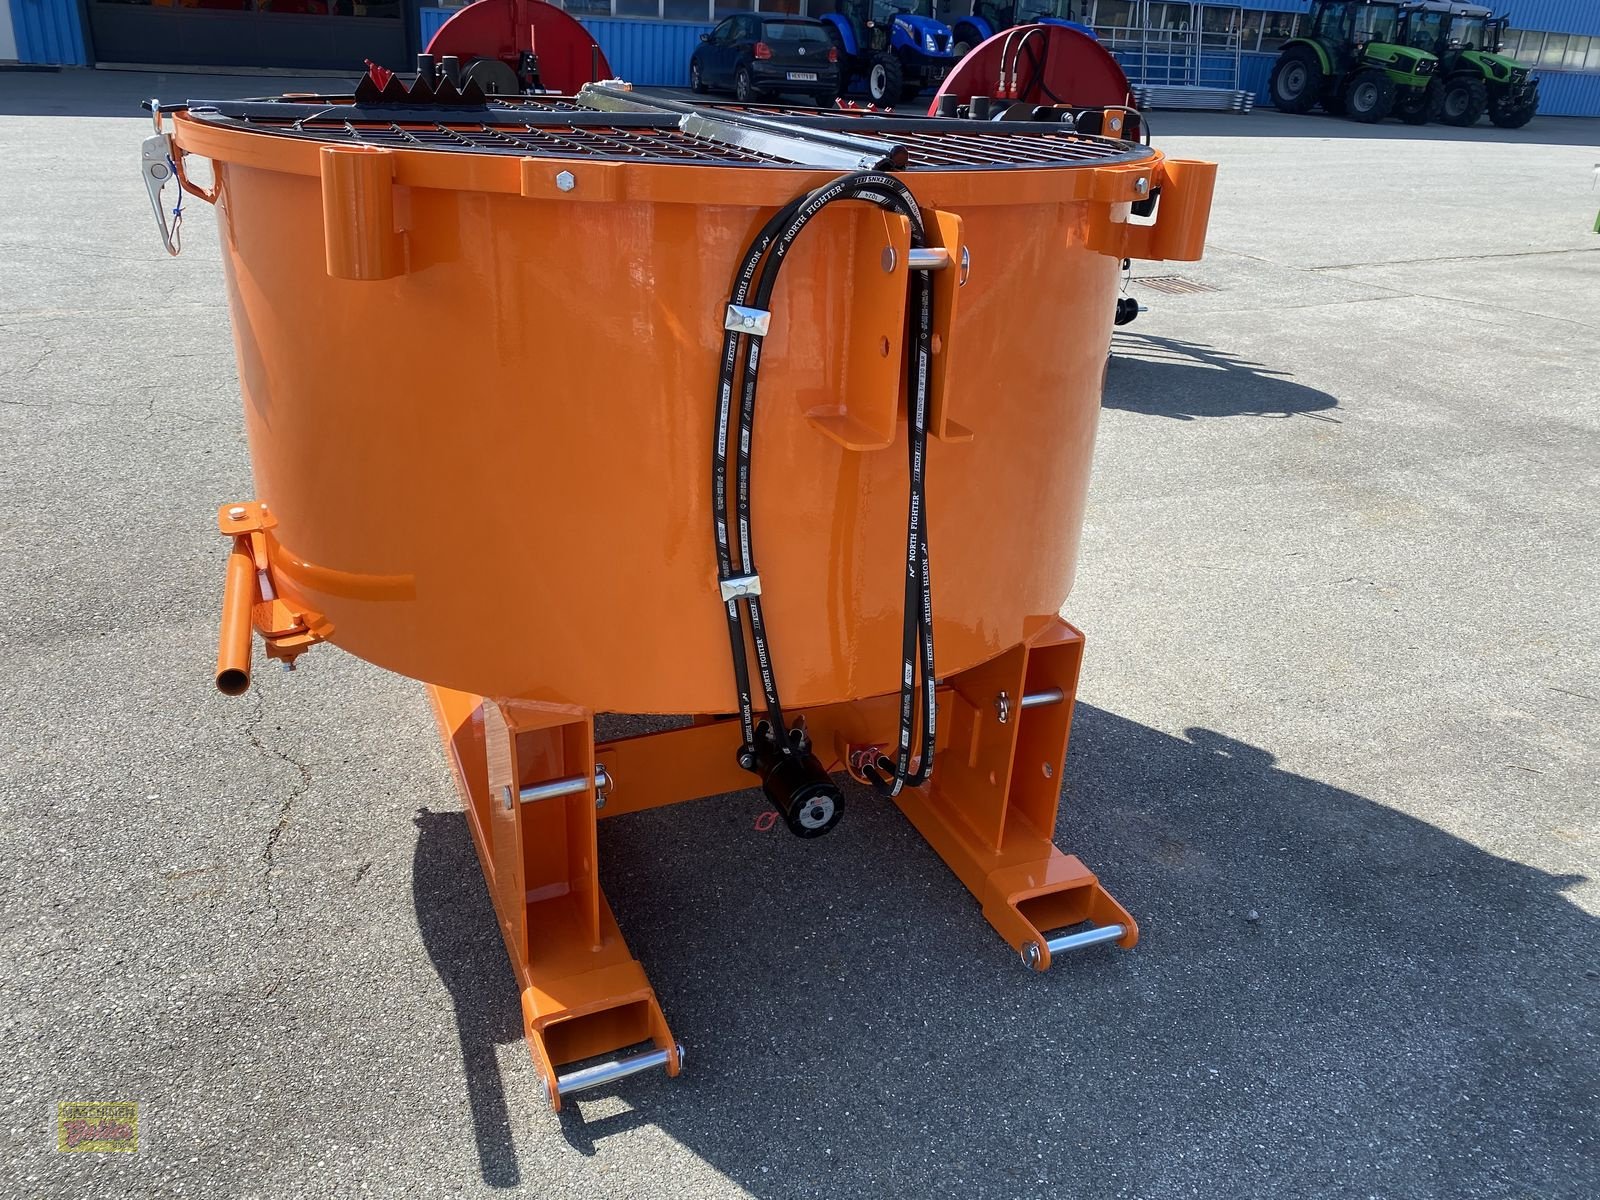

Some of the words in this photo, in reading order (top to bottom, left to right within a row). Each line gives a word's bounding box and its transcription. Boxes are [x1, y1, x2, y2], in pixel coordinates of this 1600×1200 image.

[784, 214, 807, 242] NORTH
[743, 251, 762, 279] NORTH
[908, 533, 918, 562] NORTH
[921, 558, 930, 587] NORTH
[762, 669, 773, 692] NORTH
